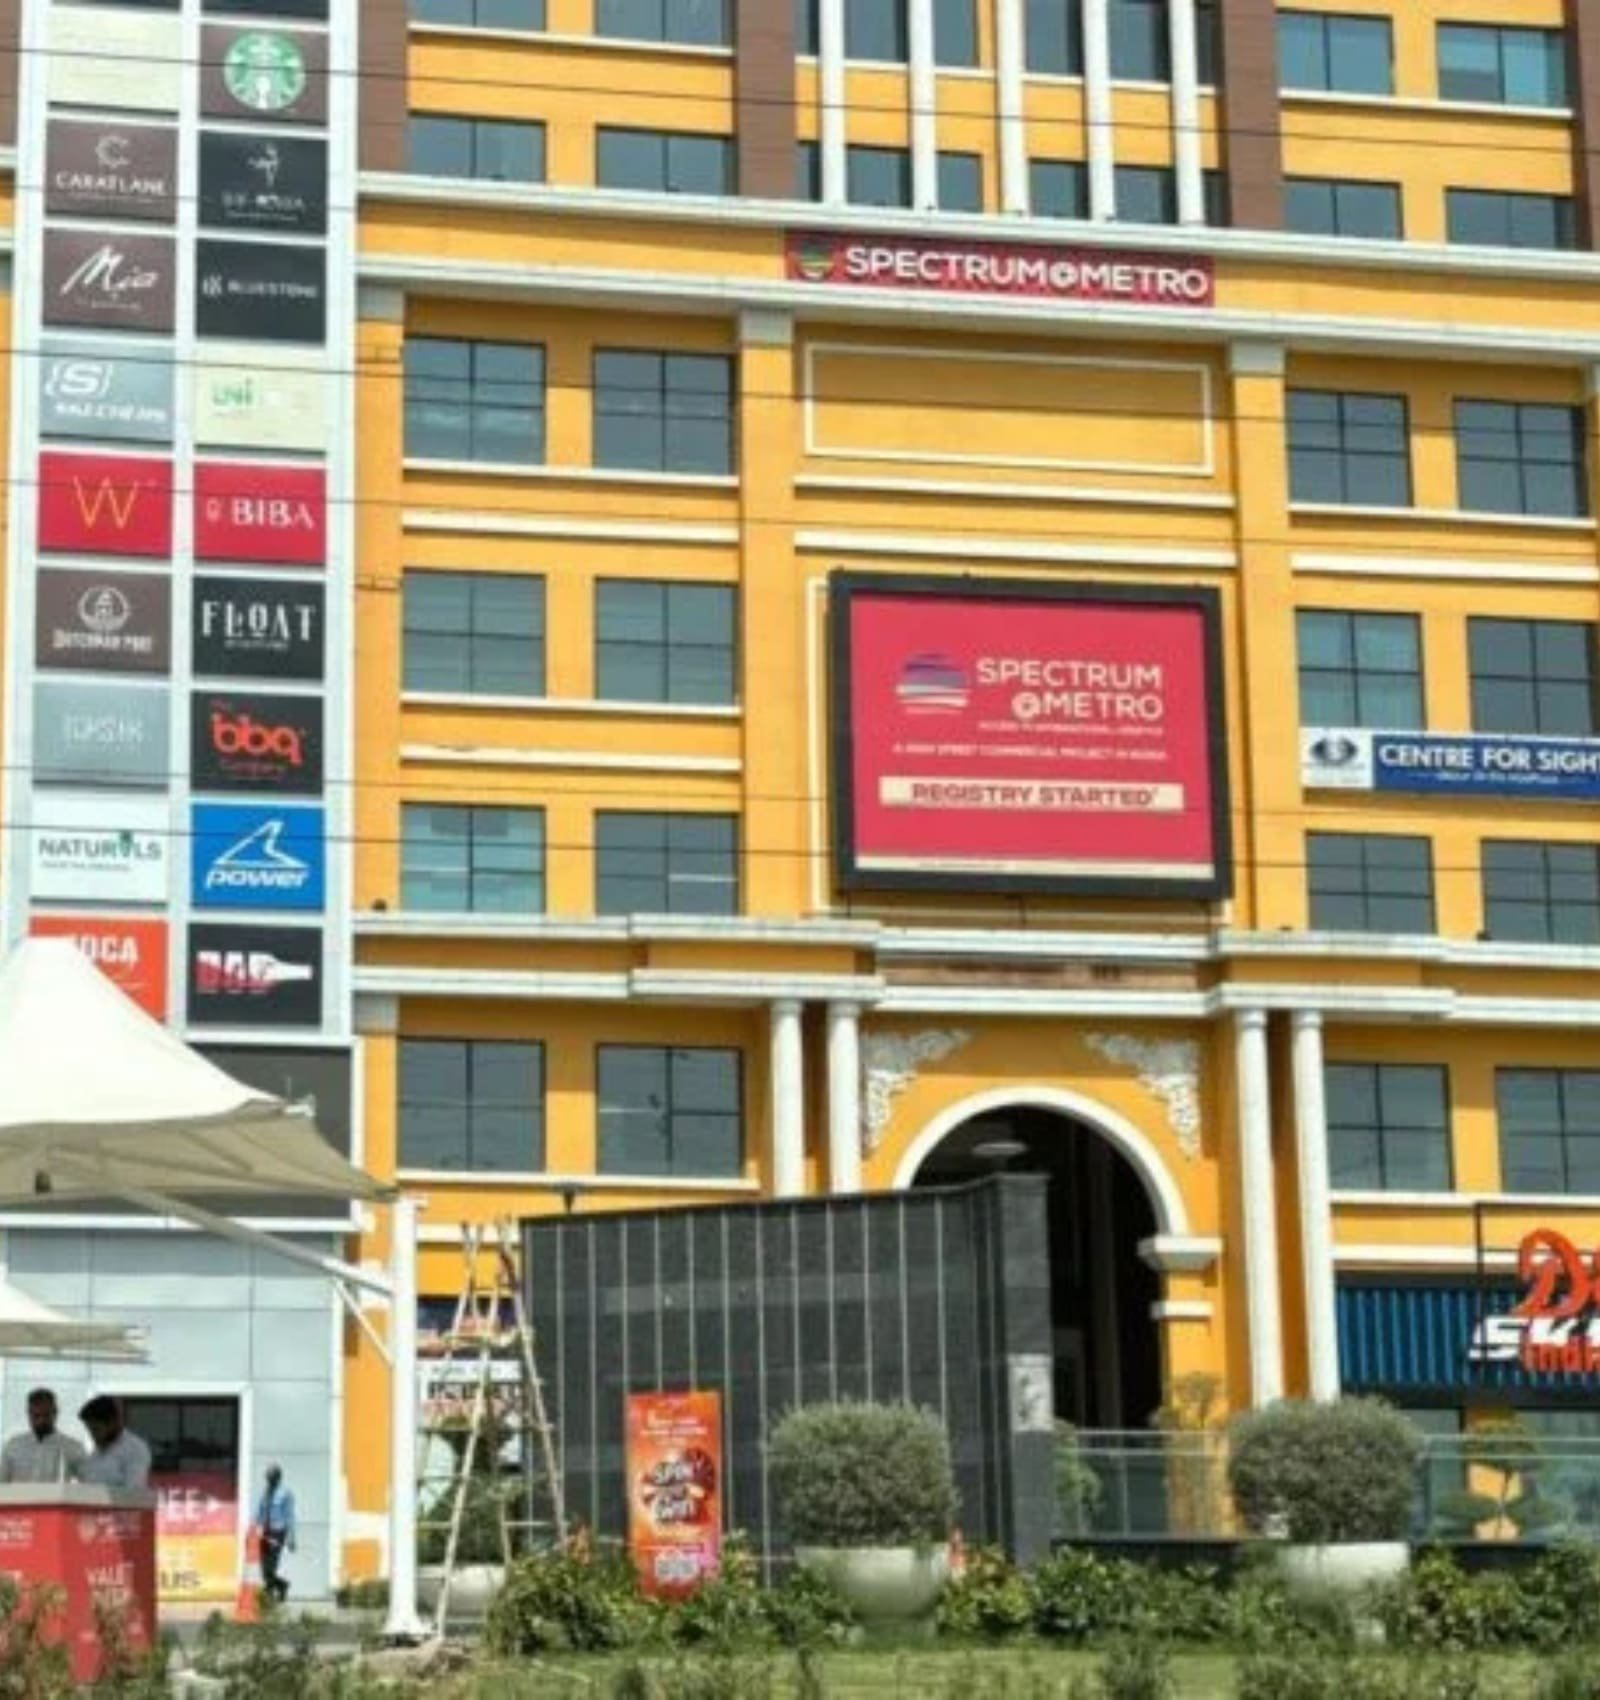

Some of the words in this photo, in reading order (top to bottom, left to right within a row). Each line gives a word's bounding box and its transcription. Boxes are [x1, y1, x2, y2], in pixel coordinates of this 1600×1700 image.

[73, 476, 139, 529] W
[231, 497, 314, 529] BIBA
[202, 600, 318, 641] FLOAT
[976, 657, 1162, 690] SPECTRUM
[211, 711, 302, 766] bbq
[1379, 745, 1474, 769] CENTRE
[1482, 747, 1531, 770] FOR
[1536, 750, 1600, 773] SIGH
[911, 783, 1034, 803] REGISTRY
[205, 868, 309, 889] power
